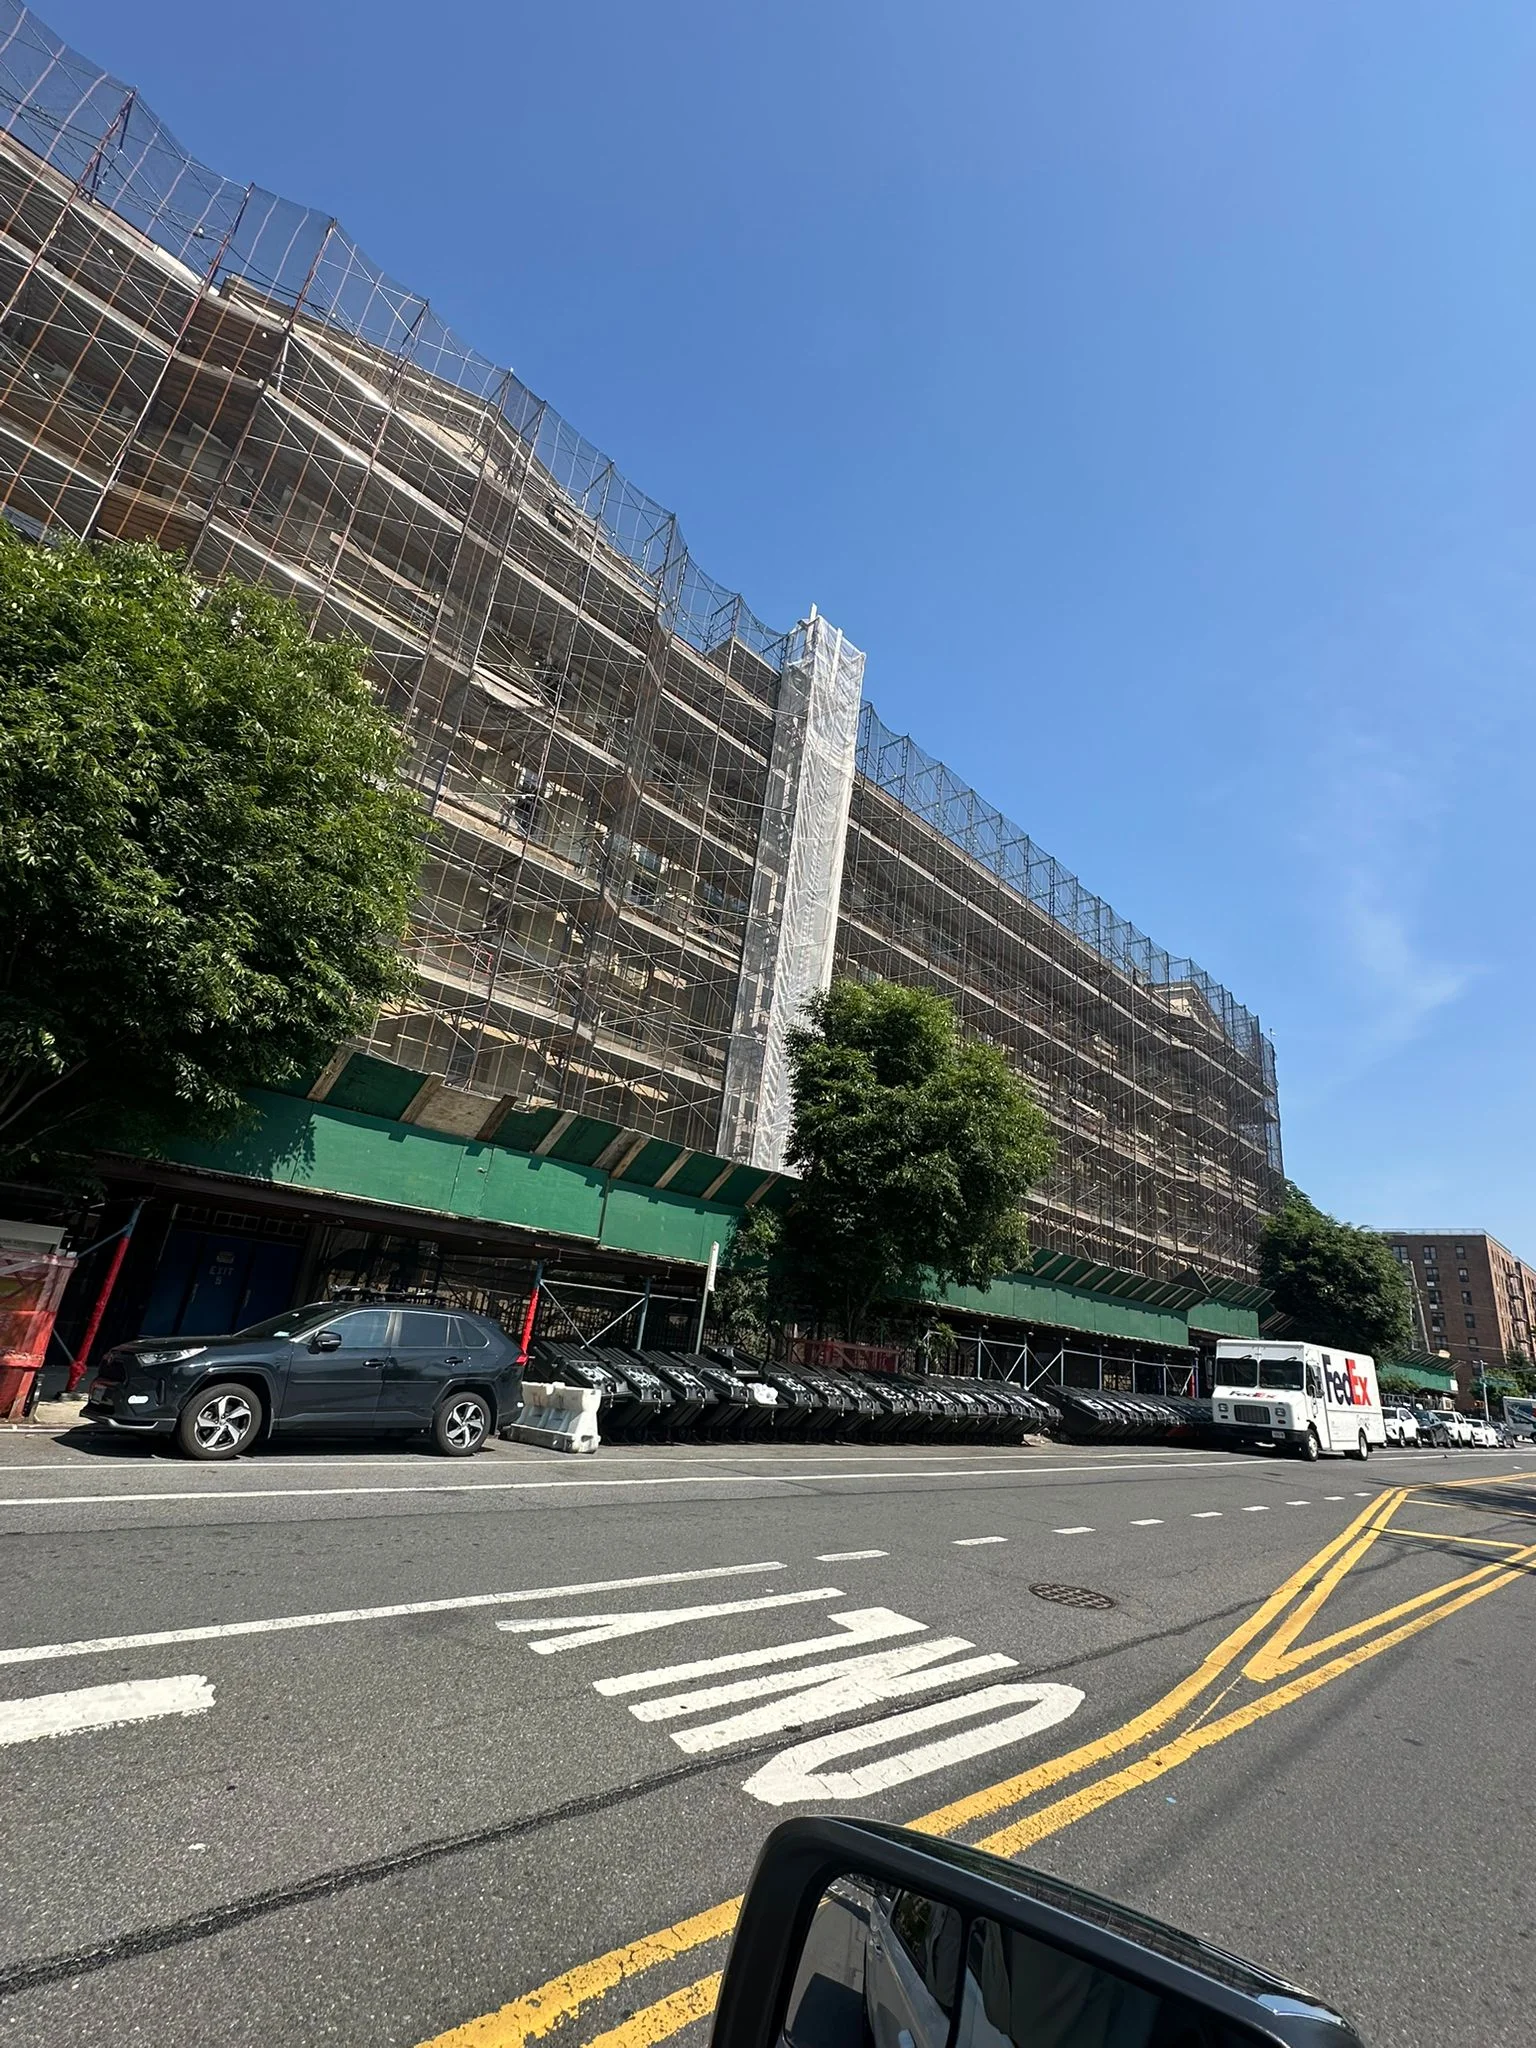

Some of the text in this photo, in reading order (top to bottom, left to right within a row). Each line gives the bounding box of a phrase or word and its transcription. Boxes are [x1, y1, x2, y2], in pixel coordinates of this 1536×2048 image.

[208, 1265, 235, 1276] EXIT
[1321, 1353, 1372, 1406] FedEx
[495, 1587, 1085, 1805] ONLY
